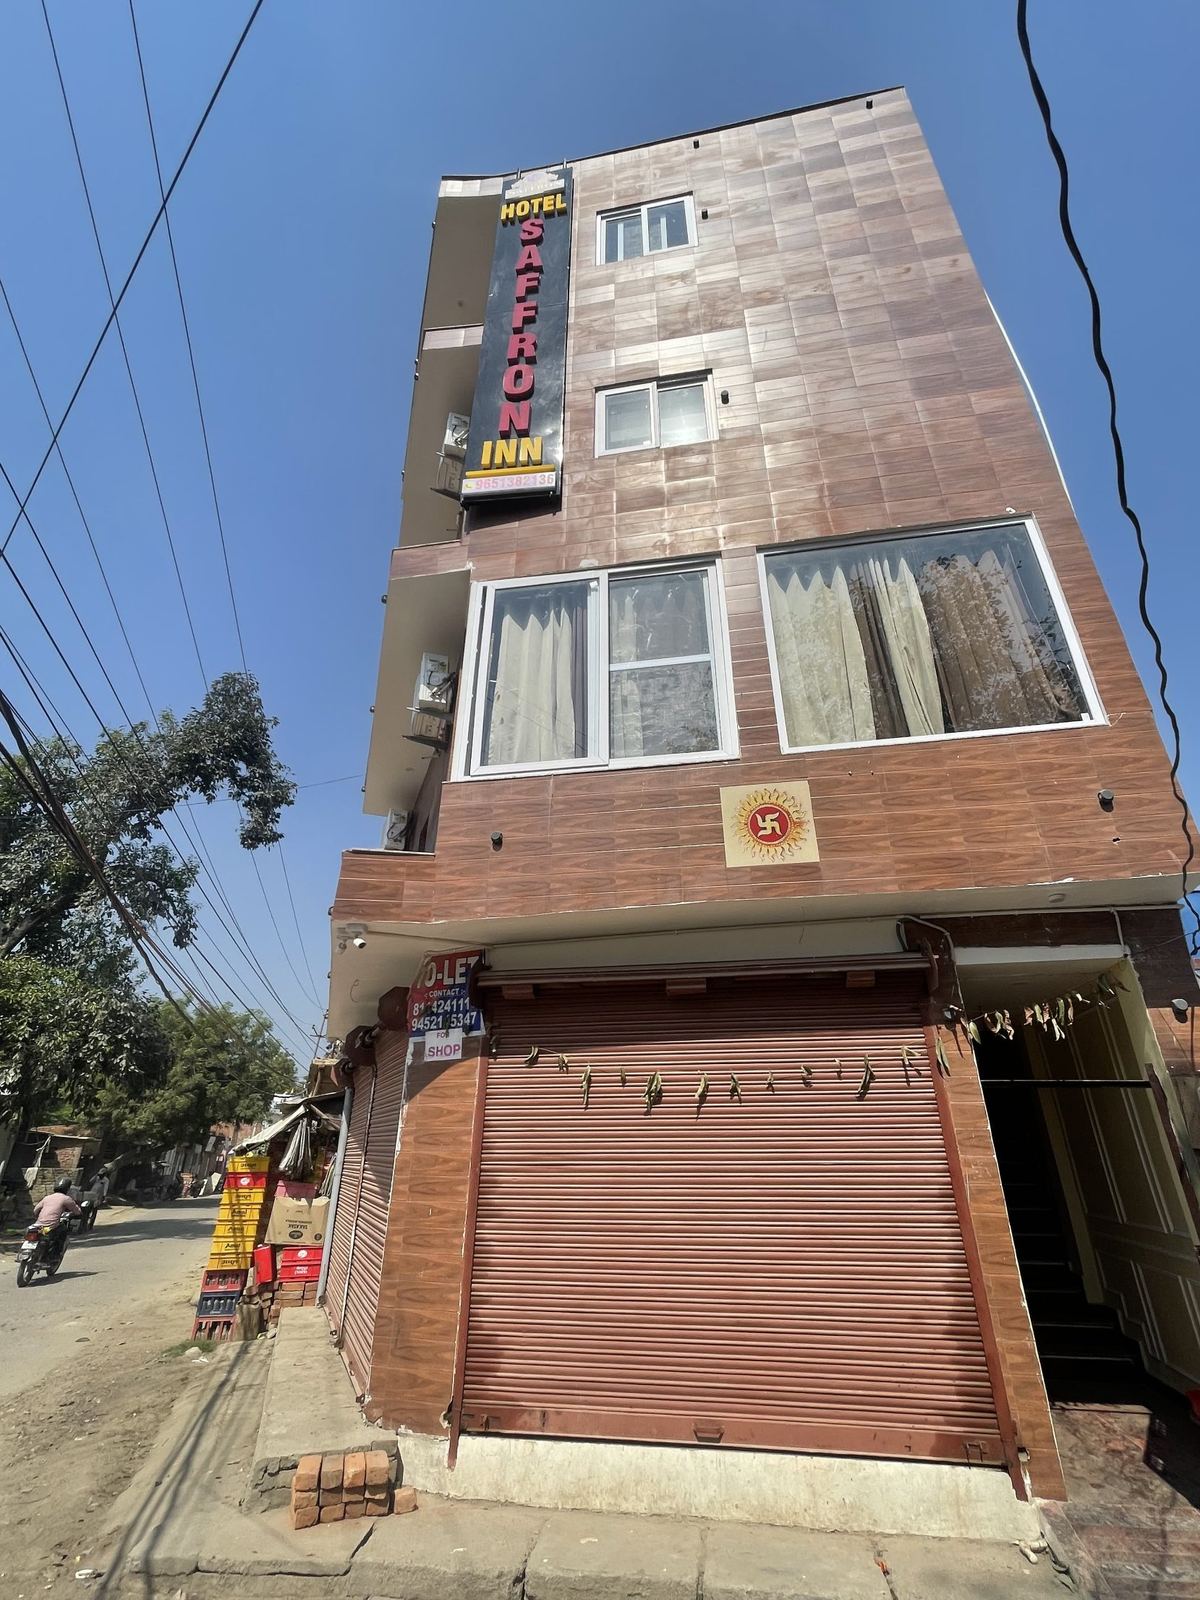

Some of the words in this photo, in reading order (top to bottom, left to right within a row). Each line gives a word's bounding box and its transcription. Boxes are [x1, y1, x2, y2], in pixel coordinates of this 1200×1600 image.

[500, 193, 567, 221] HOTEL
[499, 218, 544, 436] SAFFRON
[481, 436, 543, 465] INN
[475, 473, 554, 490] 9651382136
[429, 988, 459, 998] CONTACT
[411, 1011, 477, 1031] 945215347
[428, 1044, 460, 1057] SHOP
